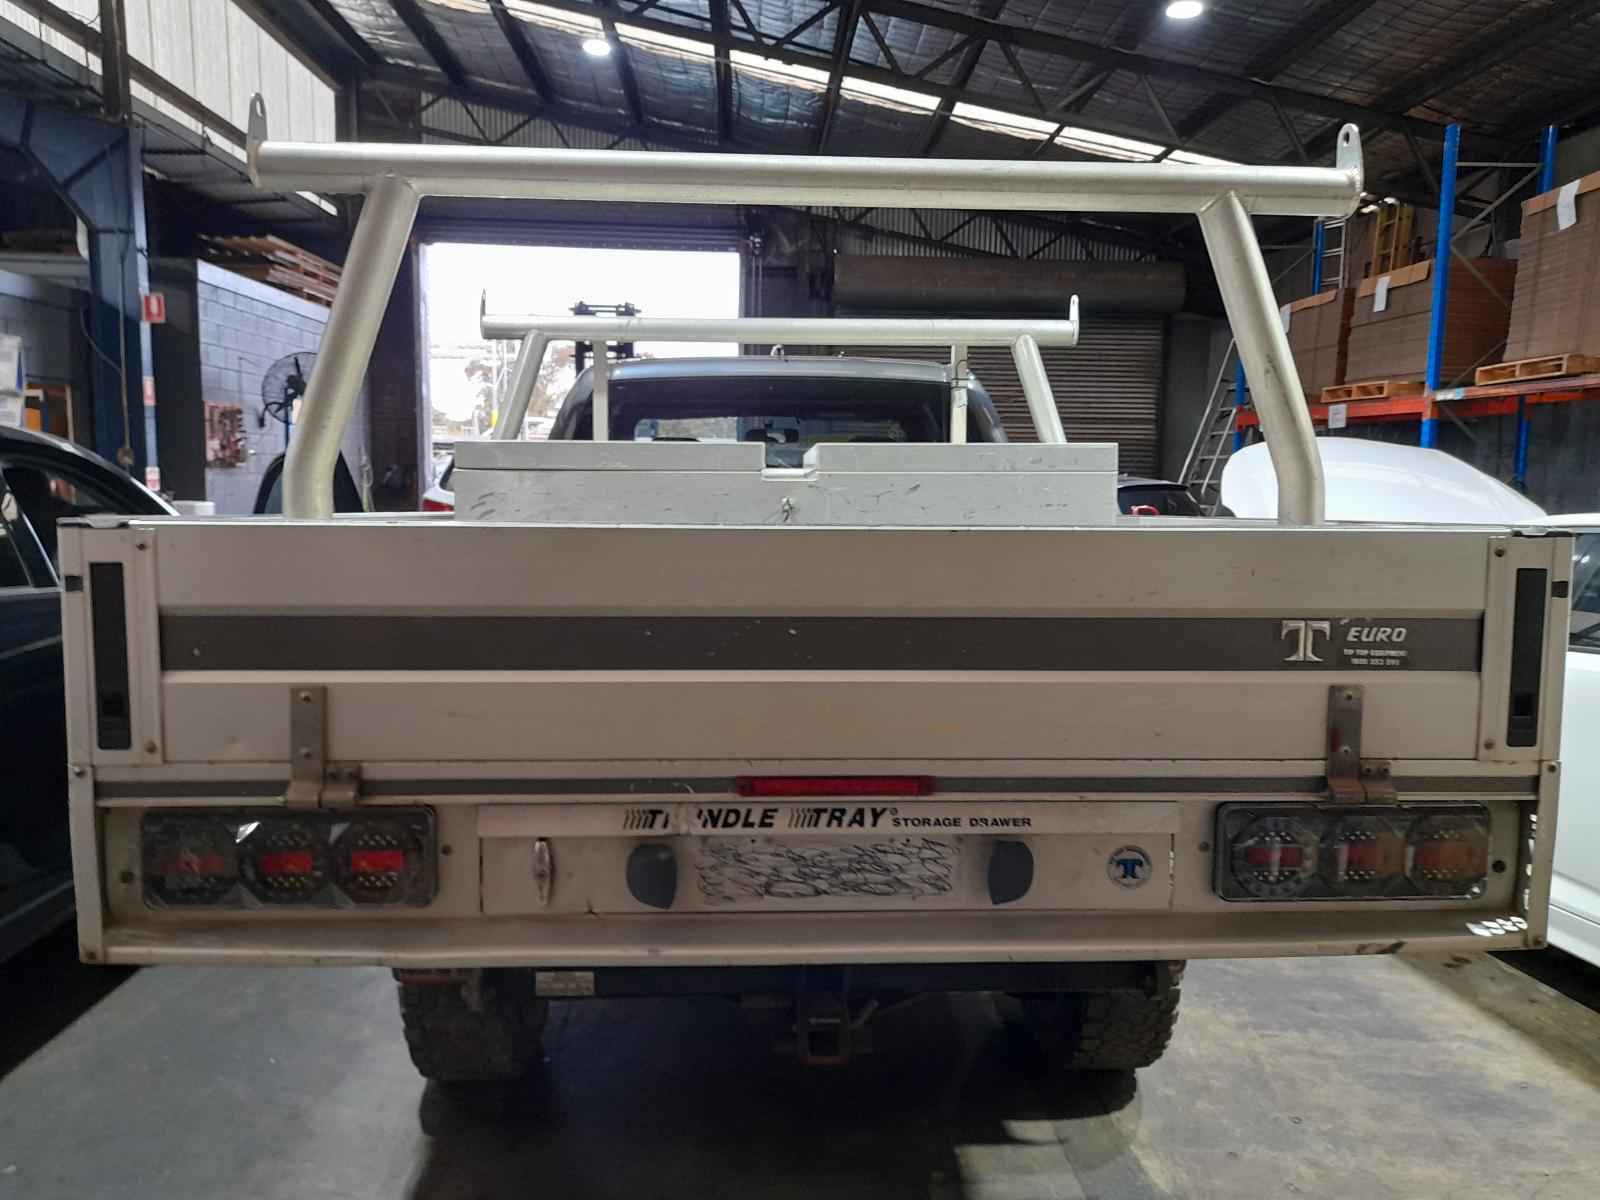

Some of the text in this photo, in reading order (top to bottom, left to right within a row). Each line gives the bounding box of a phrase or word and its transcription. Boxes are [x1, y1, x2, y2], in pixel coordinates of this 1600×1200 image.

[1346, 626, 1408, 642] EURO
[646, 808, 778, 829] TNDLE
[892, 817, 961, 828] STORAGE
[969, 817, 1032, 828] DRAWER
